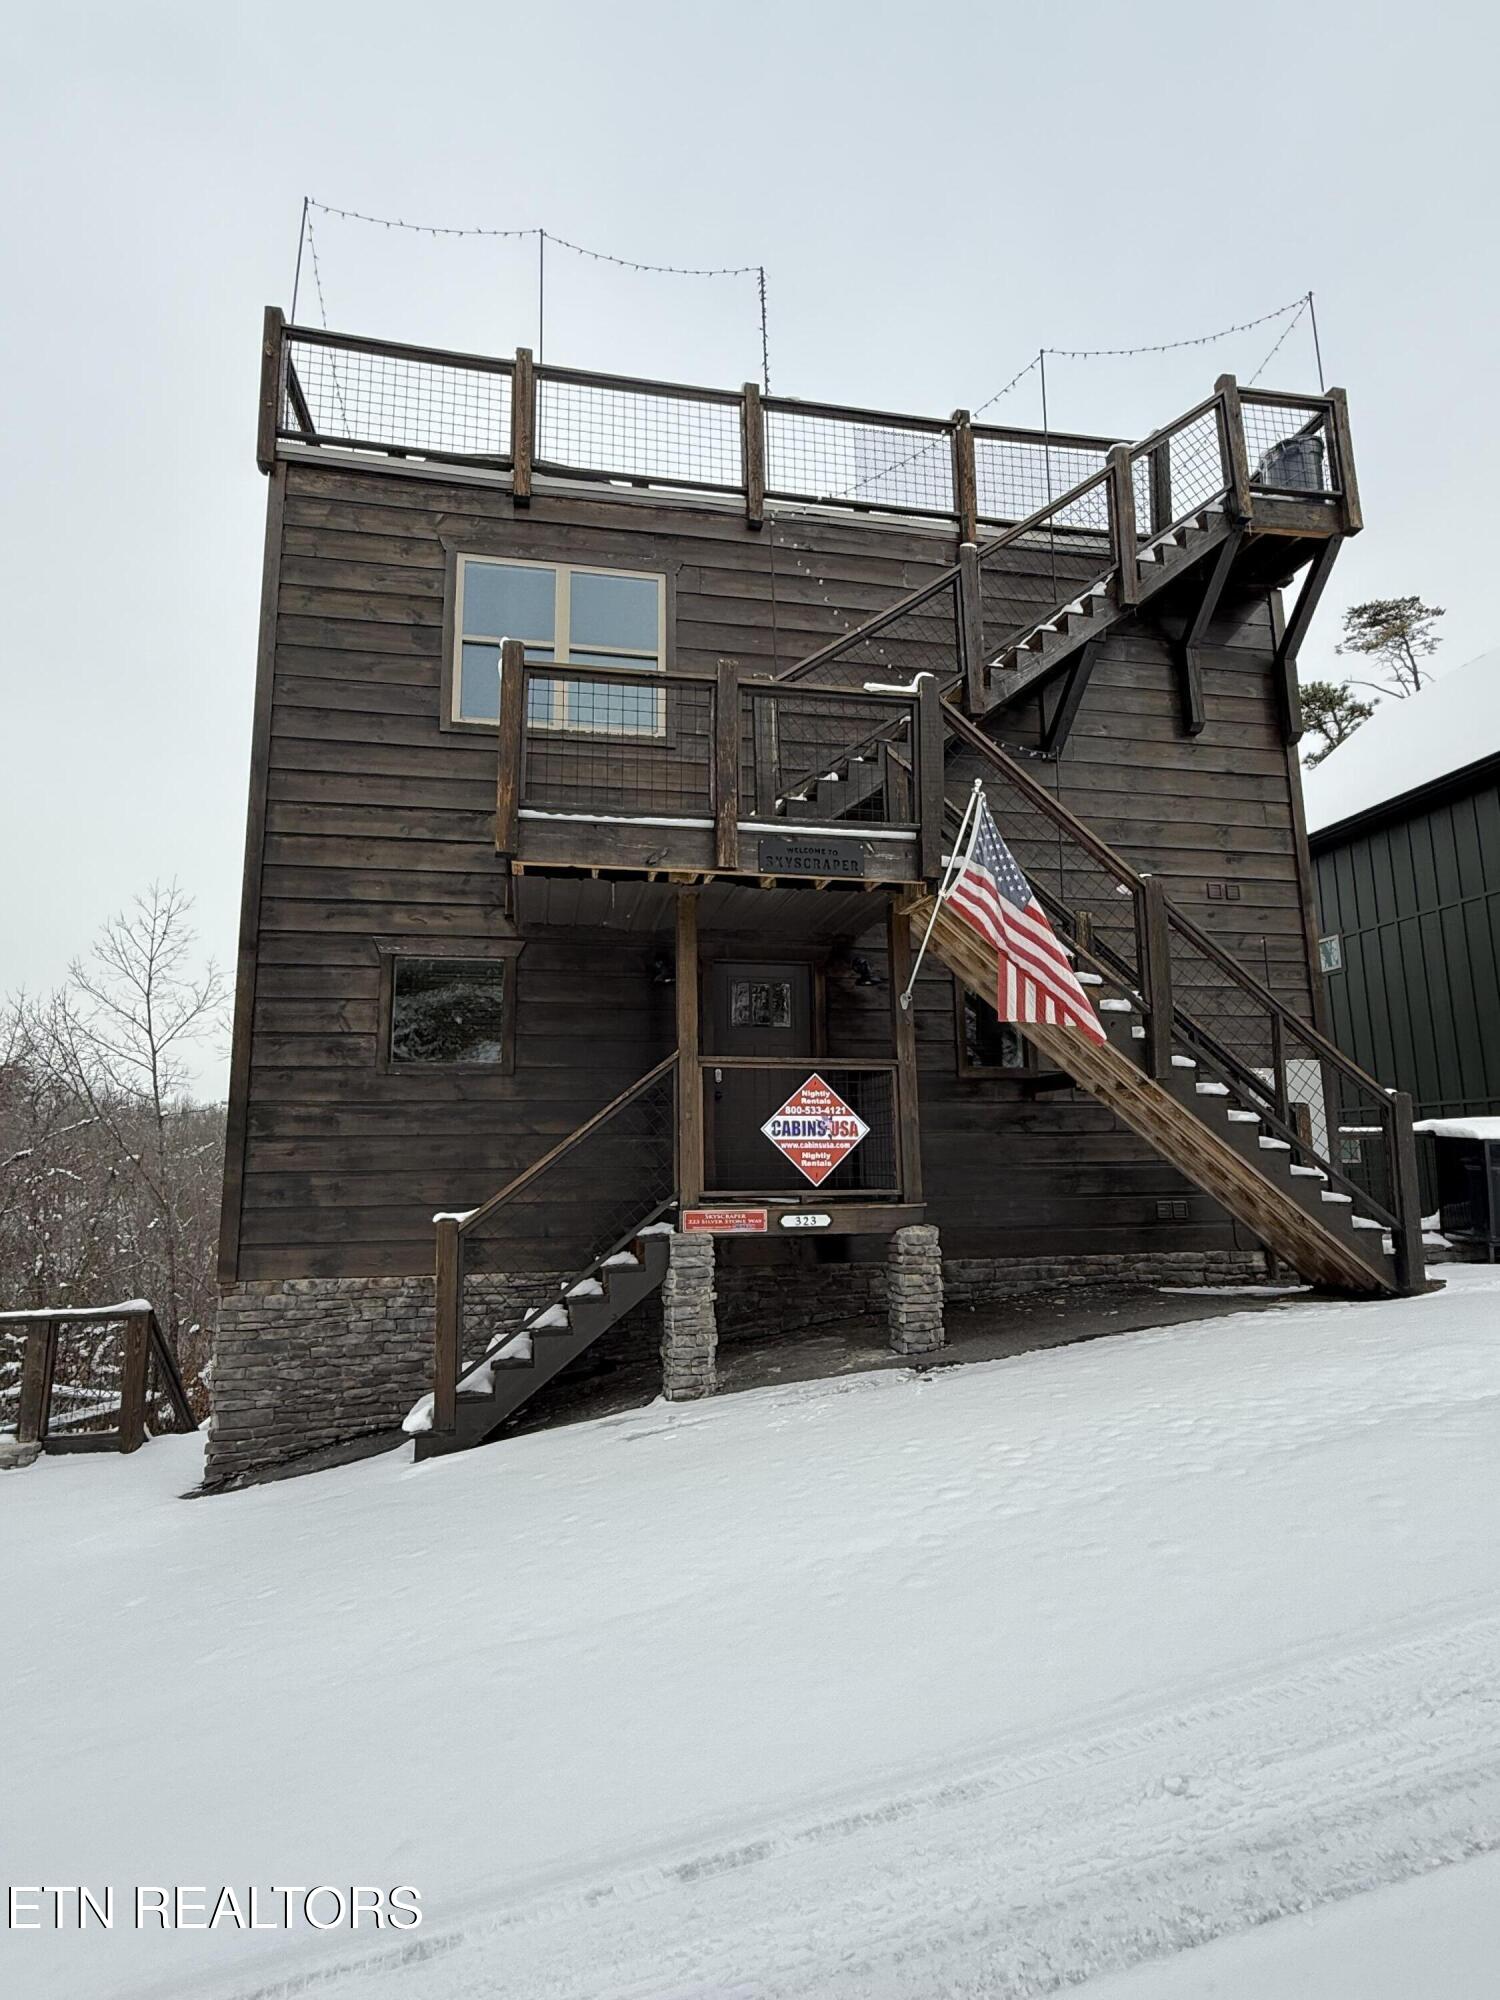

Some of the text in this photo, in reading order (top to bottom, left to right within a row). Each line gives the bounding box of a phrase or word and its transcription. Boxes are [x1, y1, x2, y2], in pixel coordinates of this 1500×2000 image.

[786, 847, 826, 855] WELCOME
[766, 855, 859, 872] SKYSCRAPER
[801, 1090, 831, 1098] Nightly
[785, 1106, 847, 1115] 800-533-4121
[771, 1120, 859, 1137] CABINS USA
[801, 1152, 831, 1160] Nightly
[795, 1216, 817, 1226] 323
